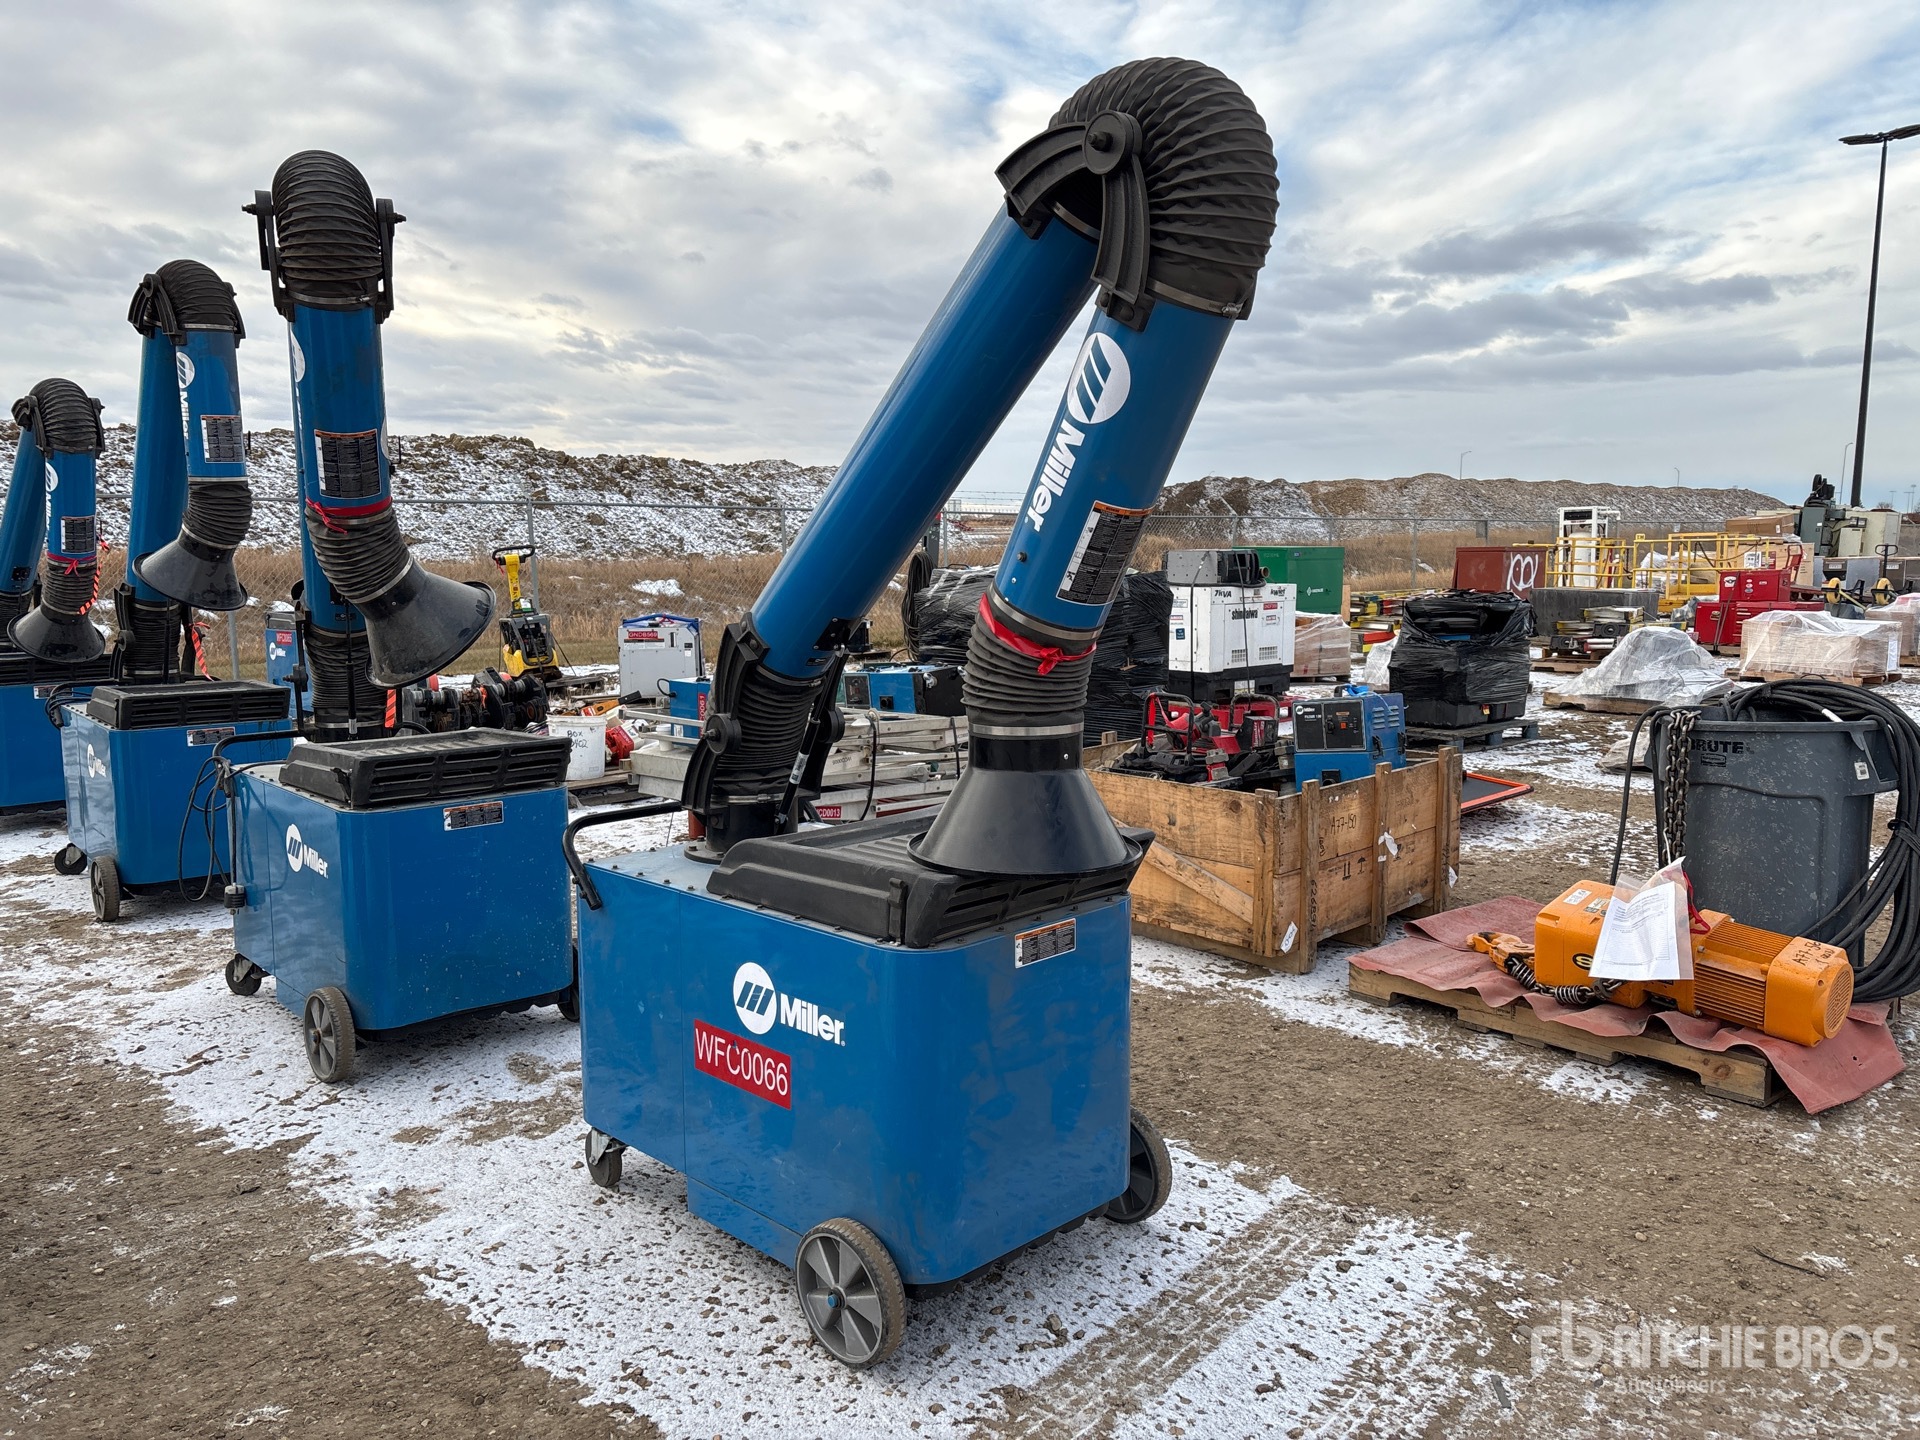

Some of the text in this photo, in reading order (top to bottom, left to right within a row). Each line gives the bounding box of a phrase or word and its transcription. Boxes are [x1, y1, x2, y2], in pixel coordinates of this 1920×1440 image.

[1026, 418, 1086, 533] Miller
[816, 808, 841, 818] CD0013
[303, 844, 328, 878] Miller
[779, 993, 845, 1046] Miller
[694, 1027, 790, 1098] WFC0066
